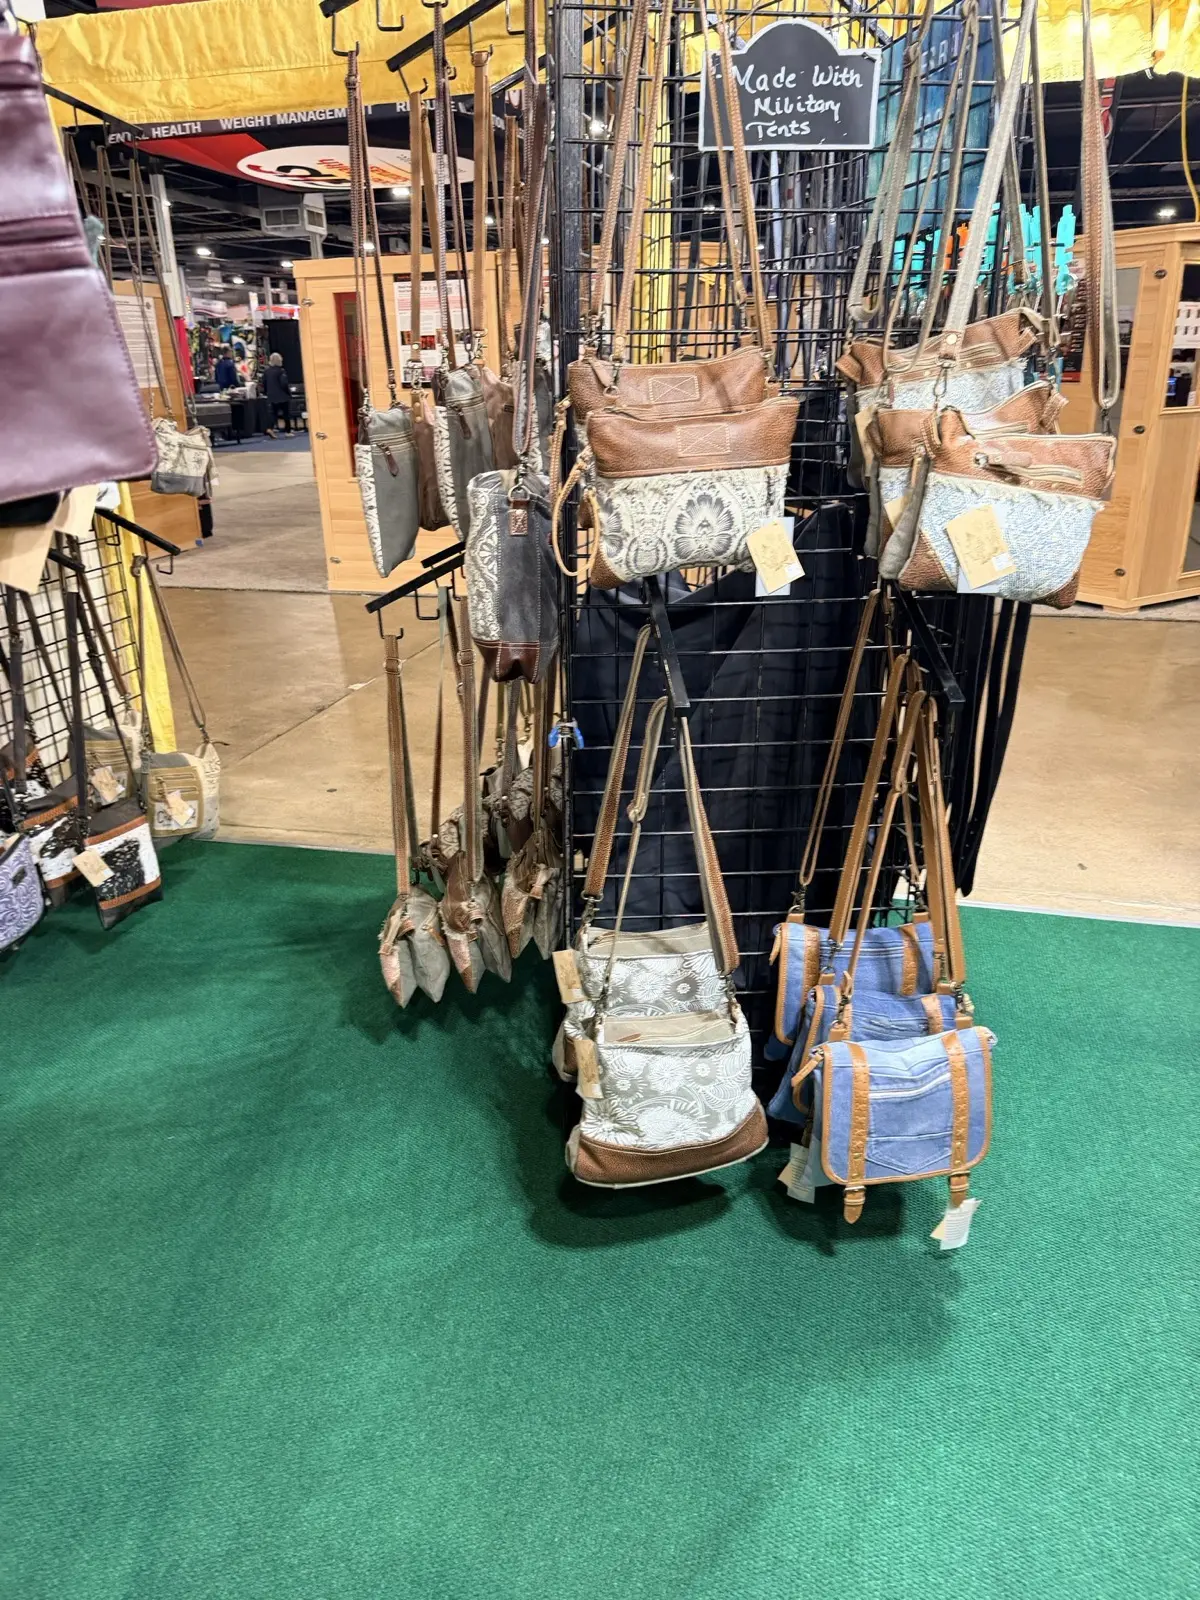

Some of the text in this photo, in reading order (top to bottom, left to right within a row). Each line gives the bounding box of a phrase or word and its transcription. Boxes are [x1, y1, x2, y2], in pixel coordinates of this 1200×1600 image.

[731, 64, 863, 94] Made With
[151, 122, 202, 138] HEALTH
[219, 115, 272, 130] WEIGHT
[276, 105, 373, 125] MANAGEMT
[745, 120, 811, 141] Tents
